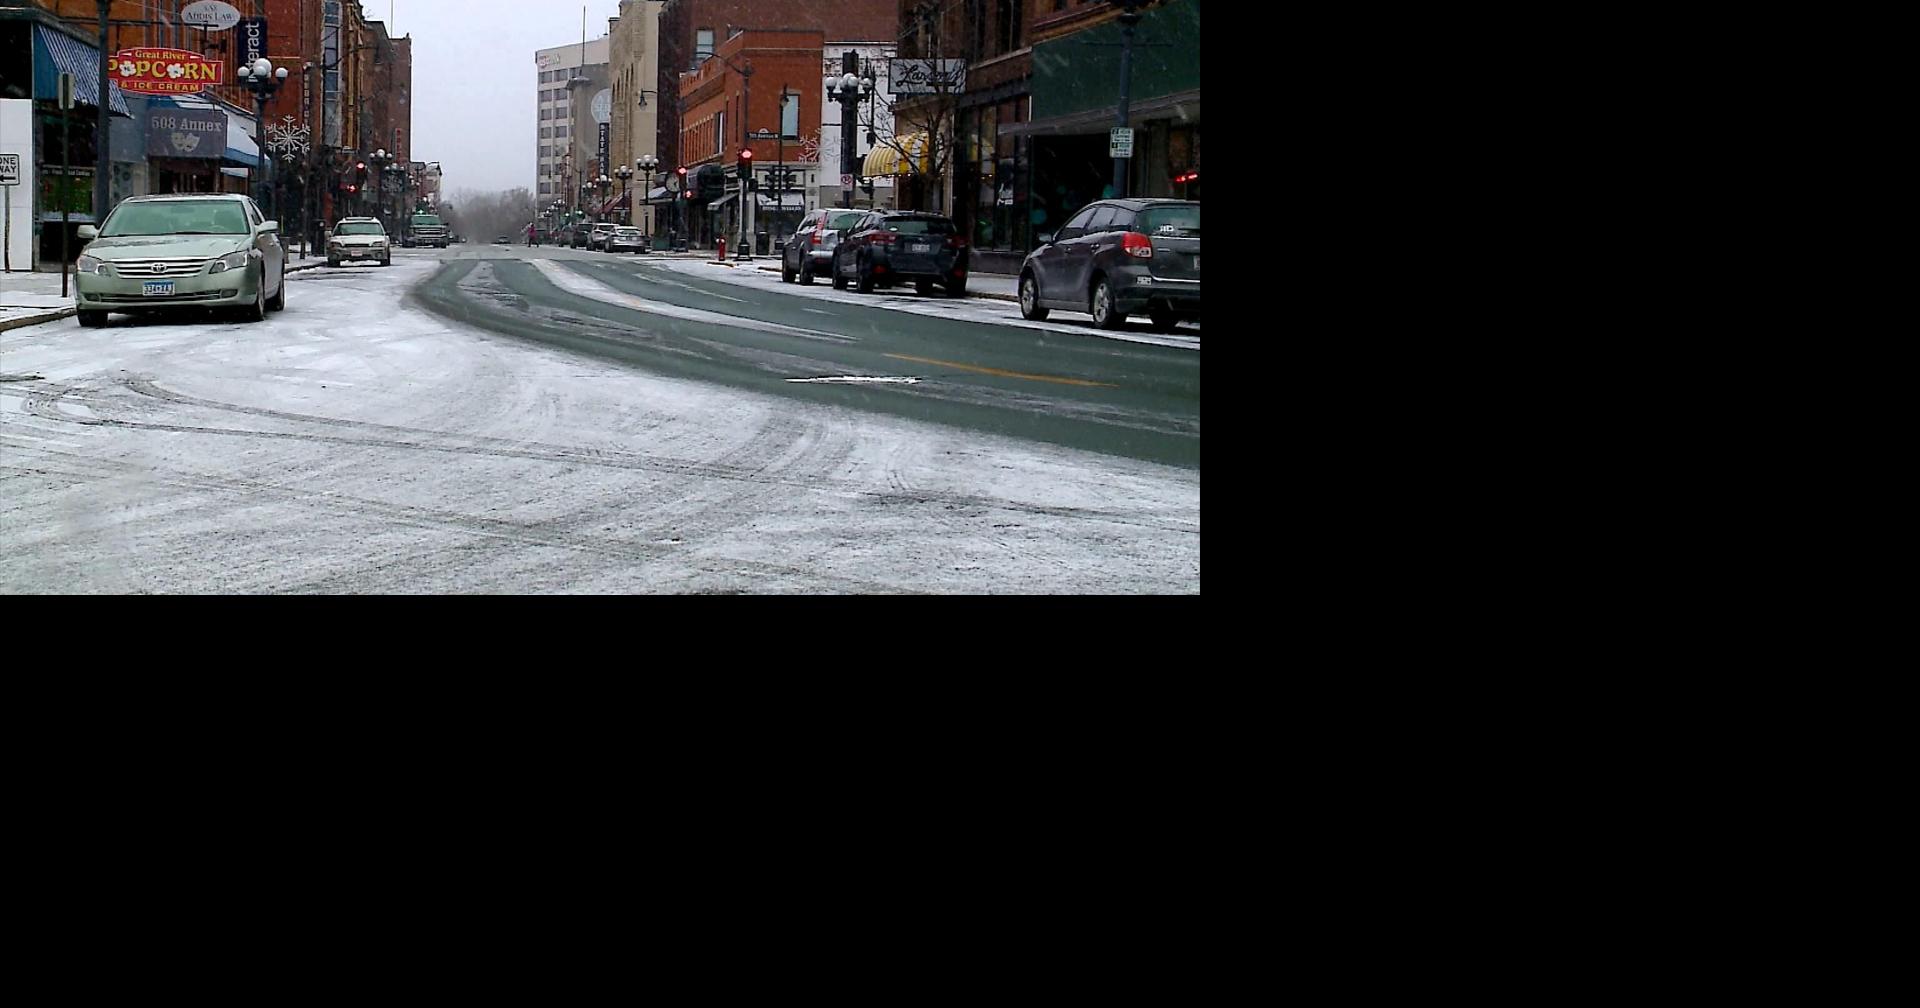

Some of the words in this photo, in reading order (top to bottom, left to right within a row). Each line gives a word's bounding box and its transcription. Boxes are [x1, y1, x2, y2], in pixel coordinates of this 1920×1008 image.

[135, 50, 160, 59] Great
[163, 51, 186, 60] River
[108, 59, 217, 80] POPCORN
[158, 83, 199, 91] CREAM
[180, 118, 223, 132] Annex
